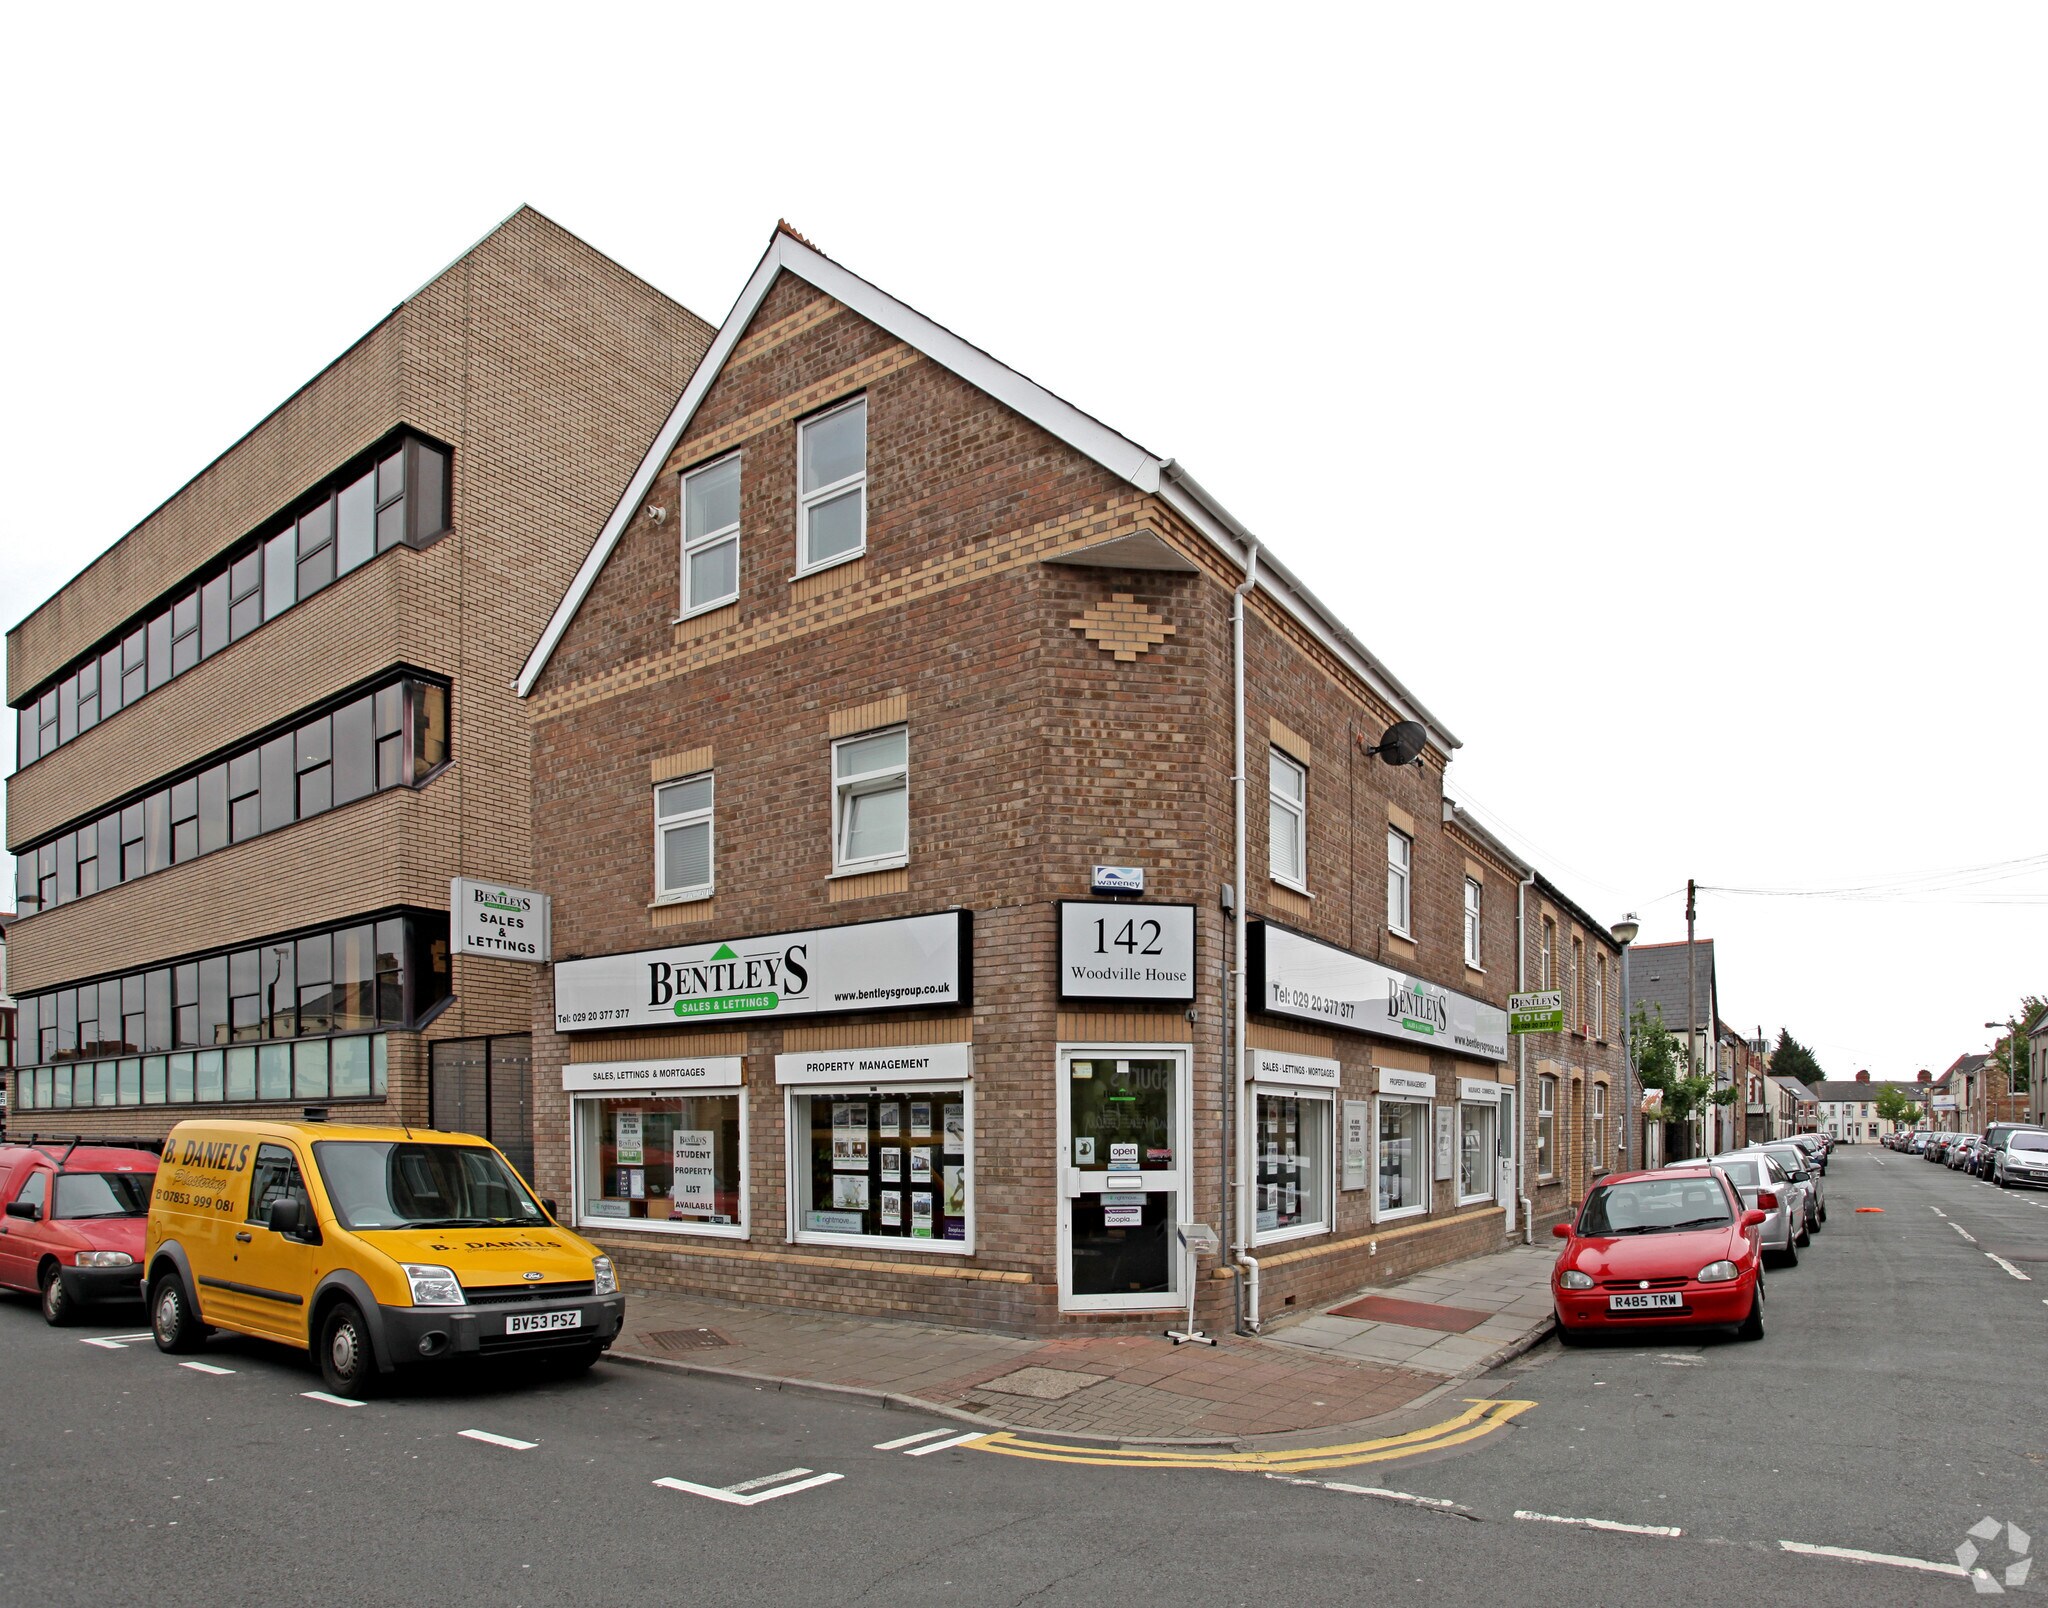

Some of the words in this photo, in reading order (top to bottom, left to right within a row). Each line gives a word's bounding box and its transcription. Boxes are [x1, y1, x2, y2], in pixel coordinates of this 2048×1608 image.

[1097, 879, 1140, 888] waveney
[474, 889, 531, 911] BENTLEYS
[479, 912, 524, 928] SALES
[498, 927, 506, 937] &
[1093, 917, 1163, 955] 142
[467, 935, 536, 954] LETTINGS
[647, 944, 809, 1006] BENTLEYS
[1071, 966, 1141, 980] Woodville
[1145, 968, 1187, 981] House
[834, 982, 950, 1001] www.bentleysgroup.co.uk
[682, 1001, 710, 1013] SALES
[713, 1000, 719, 1010] &
[722, 996, 769, 1010] LETTINGS
[1273, 984, 1290, 1004] Tel:
[1292, 990, 1309, 1009] 029
[1311, 995, 1321, 1012] 20
[1324, 998, 1338, 1015] 377
[1340, 1003, 1354, 1019] 377
[1387, 977, 1447, 1031] BENTLEYS
[1511, 994, 1560, 1009] BENTLEYS
[557, 1014, 571, 1023] Tel:
[572, 1012, 586, 1022] 029
[588, 1011, 598, 1021] 20
[599, 1010, 613, 1020] 377
[615, 1009, 630, 1019] 377
[1518, 1014, 1532, 1022] TO
[1534, 1012, 1553, 1021] LET
[1454, 1035, 1505, 1055] www.bentleysgroup.co.uk
[806, 1061, 855, 1072] PROPERTY
[859, 1058, 929, 1070] MANAGEMENT
[1262, 1062, 1279, 1072] SALES
[1282, 1064, 1305, 1075] LETTINGS
[1308, 1067, 1335, 1078] MORTGAGES
[593, 1072, 615, 1081] SALES,
[617, 1070, 650, 1080] LETTINGS
[653, 1070, 658, 1078] &
[660, 1067, 705, 1078] MORTGAGES
[1390, 1078, 1406, 1086] PROPERTY
[680, 1136, 707, 1145] BENTLEYS
[163, 1138, 177, 1164] B.
[182, 1140, 250, 1172] DANIELS
[676, 1151, 711, 1159] STUDENT
[1112, 1148, 1136, 1156] open
[675, 1166, 713, 1175] PROPERTY
[172, 1168, 227, 1195] Plastering
[686, 1185, 701, 1193] LIST
[163, 1190, 191, 1205] 07853
[193, 1195, 212, 1208] 999
[215, 1199, 235, 1212] 081
[676, 1201, 713, 1210] AVAILABLE
[465, 1241, 562, 1249] DANIELS
[1615, 1296, 1648, 1307] R485
[1651, 1294, 1677, 1306] TRW
[512, 1315, 548, 1331] BV53
[551, 1313, 576, 1328] PSZ
